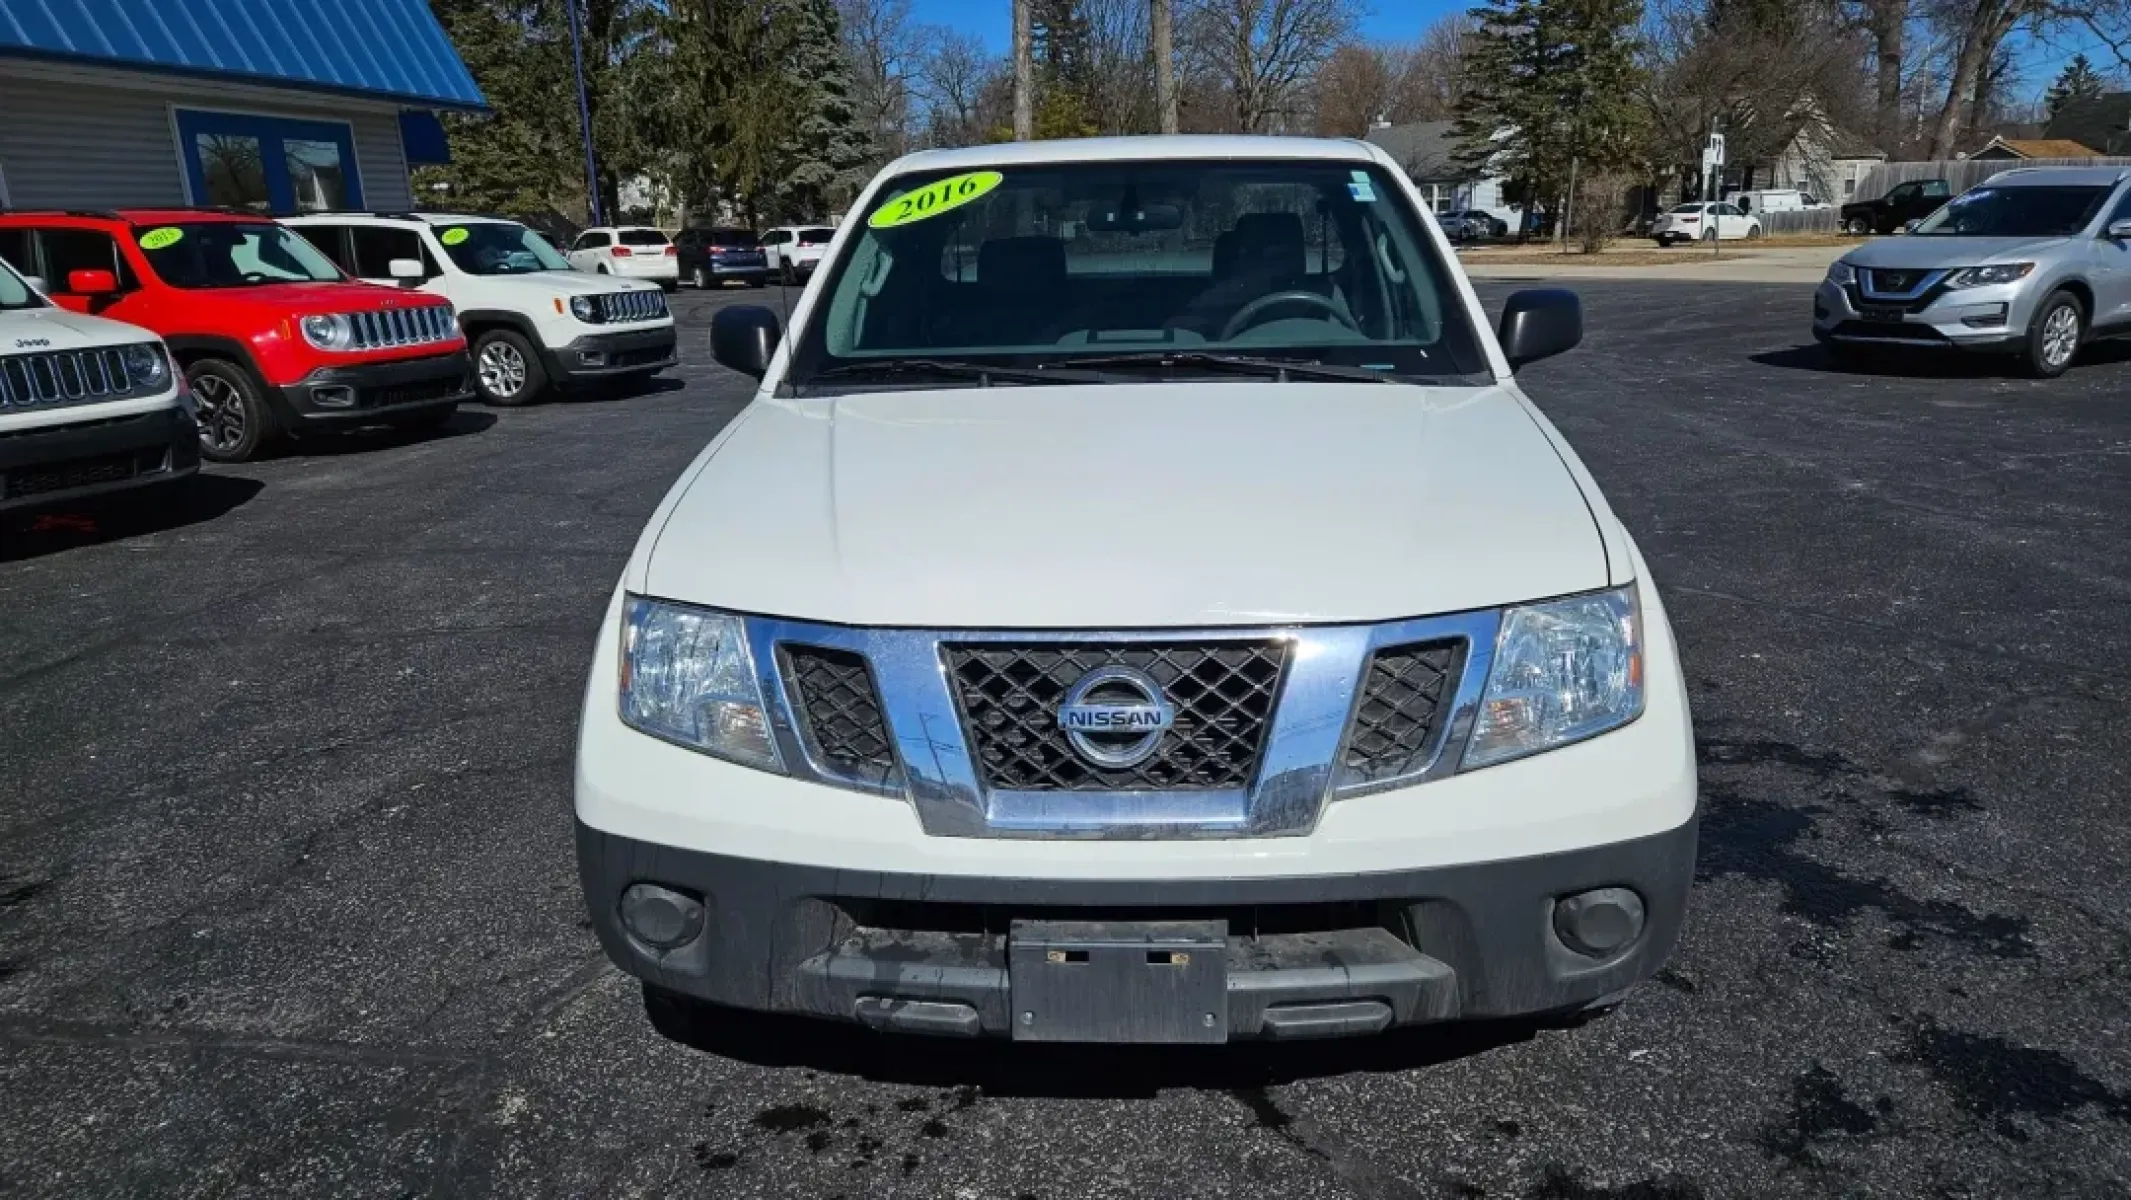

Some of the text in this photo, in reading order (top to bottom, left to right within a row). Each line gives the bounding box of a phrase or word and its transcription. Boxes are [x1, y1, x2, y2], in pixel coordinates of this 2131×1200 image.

[895, 179, 978, 221] 2016
[15, 338, 50, 348] Jeep
[1068, 711, 1161, 727] NISSAN
